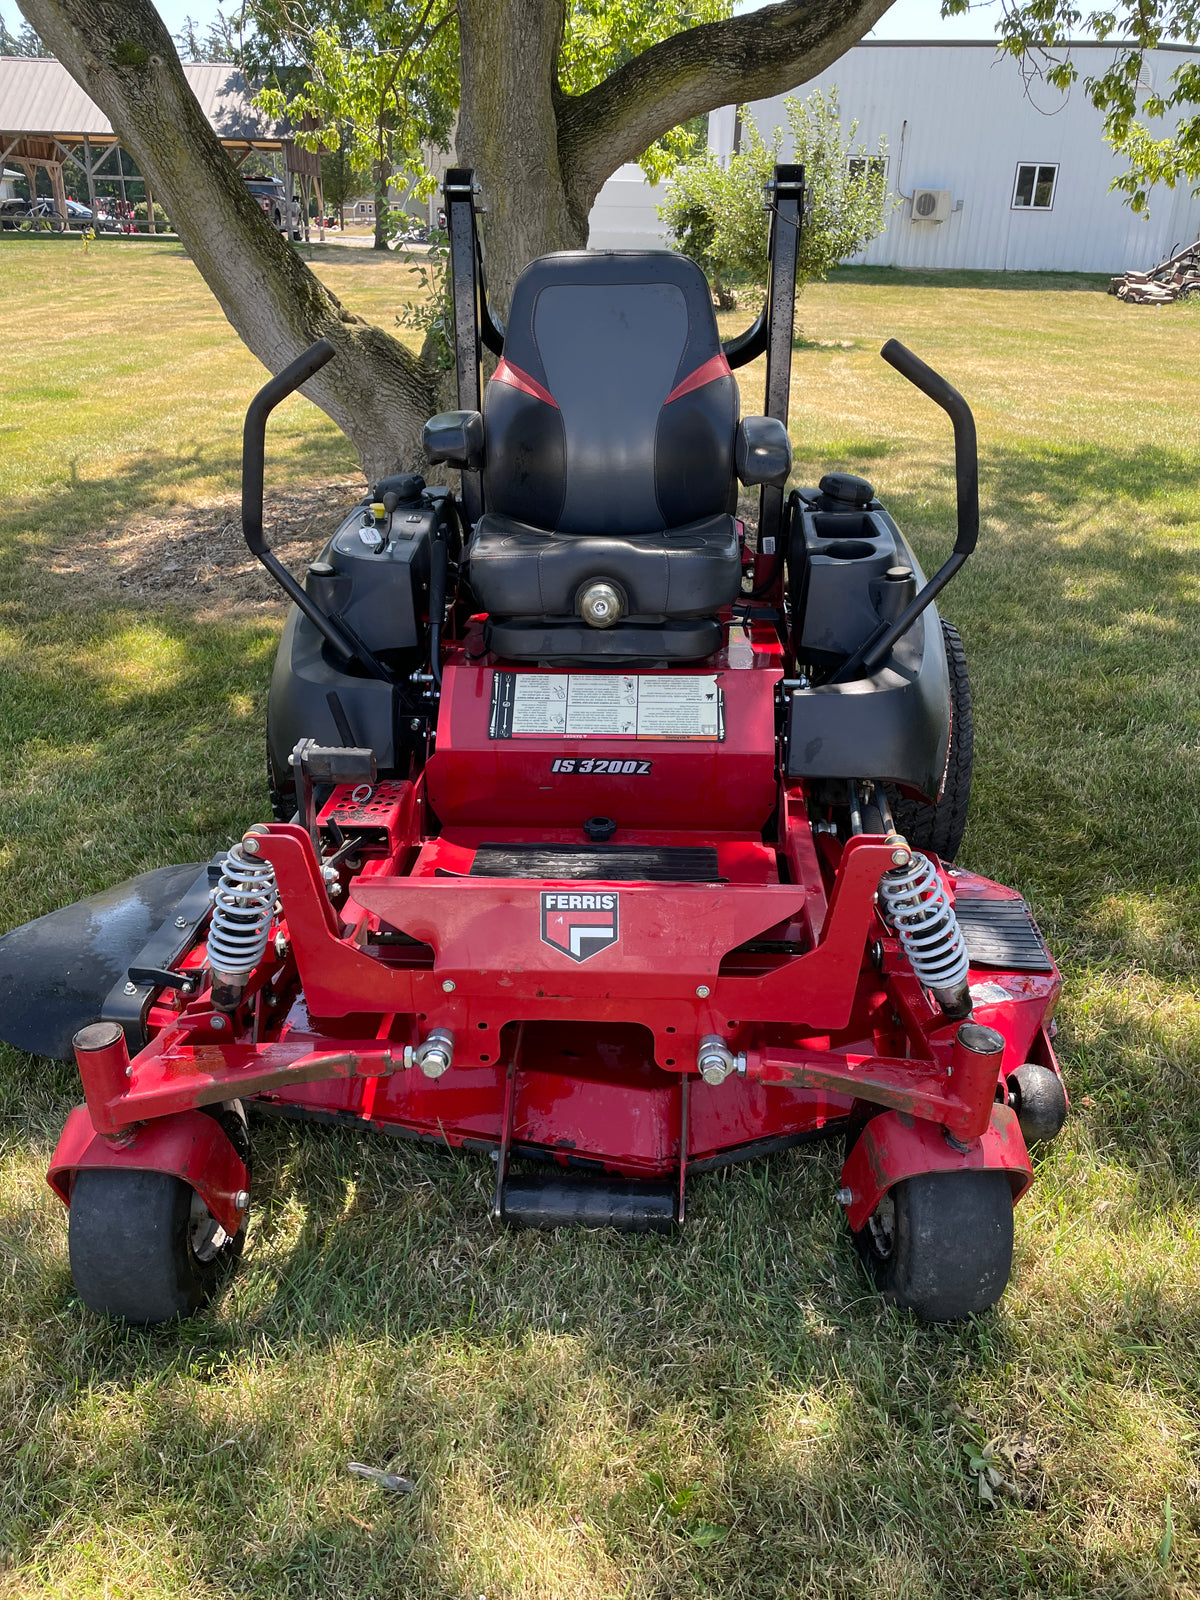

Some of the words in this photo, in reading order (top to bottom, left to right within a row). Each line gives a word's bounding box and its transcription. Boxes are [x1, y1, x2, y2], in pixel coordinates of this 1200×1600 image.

[552, 760, 574, 773] IS
[579, 760, 650, 774] 3200Z
[546, 895, 613, 909] FERRIS
